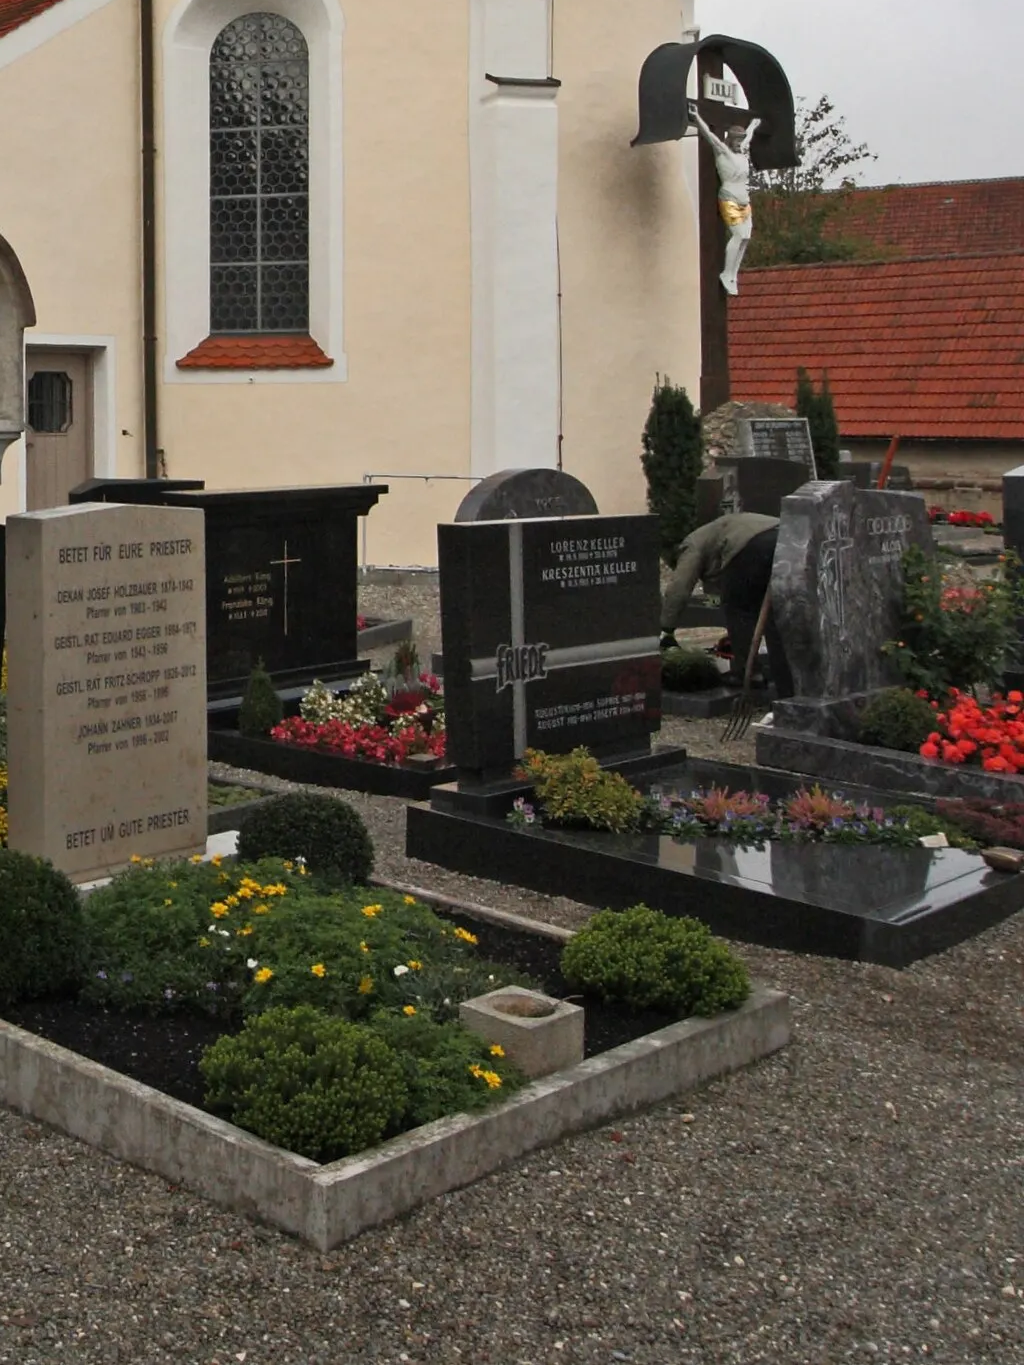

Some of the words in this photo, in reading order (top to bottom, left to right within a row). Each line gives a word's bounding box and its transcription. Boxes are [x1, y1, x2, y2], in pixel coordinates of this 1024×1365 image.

[59, 546, 88, 564] BETET
[119, 542, 143, 560] EURE
[150, 538, 192, 557] PRIESTER
[551, 539, 589, 554] LORENZ
[590, 536, 625, 551] KELLER
[542, 564, 601, 582] KRESZENTIA
[603, 561, 637, 575] KELLER
[58, 587, 84, 603] DEKAN
[87, 585, 111, 601] JOSEF
[114, 581, 158, 599] HOLZBAUER
[86, 606, 110, 619] Pfarrer
[114, 606, 126, 616] von
[54, 636, 82, 650] GEISTL.
[85, 633, 98, 646] RAT
[103, 629, 133, 644] EDUARD
[136, 626, 161, 640] EGGER
[87, 652, 111, 664] Pfarrer
[114, 650, 127, 661] von
[496, 642, 550, 693] FRIEDE
[87, 677, 101, 691] RAT
[104, 674, 125, 690] FRITZ
[126, 669, 161, 686] SCHROPP
[87, 697, 111, 709] Pfarrer
[115, 694, 127, 705] von
[78, 721, 108, 739] JOHANN
[112, 716, 141, 733] ZAHNER
[87, 743, 112, 756] Pfarrer
[115, 739, 128, 750] von
[66, 828, 96, 849] BETET
[100, 824, 115, 842] UM
[119, 818, 144, 839] GUTE
[147, 809, 190, 832] PRIESTER
